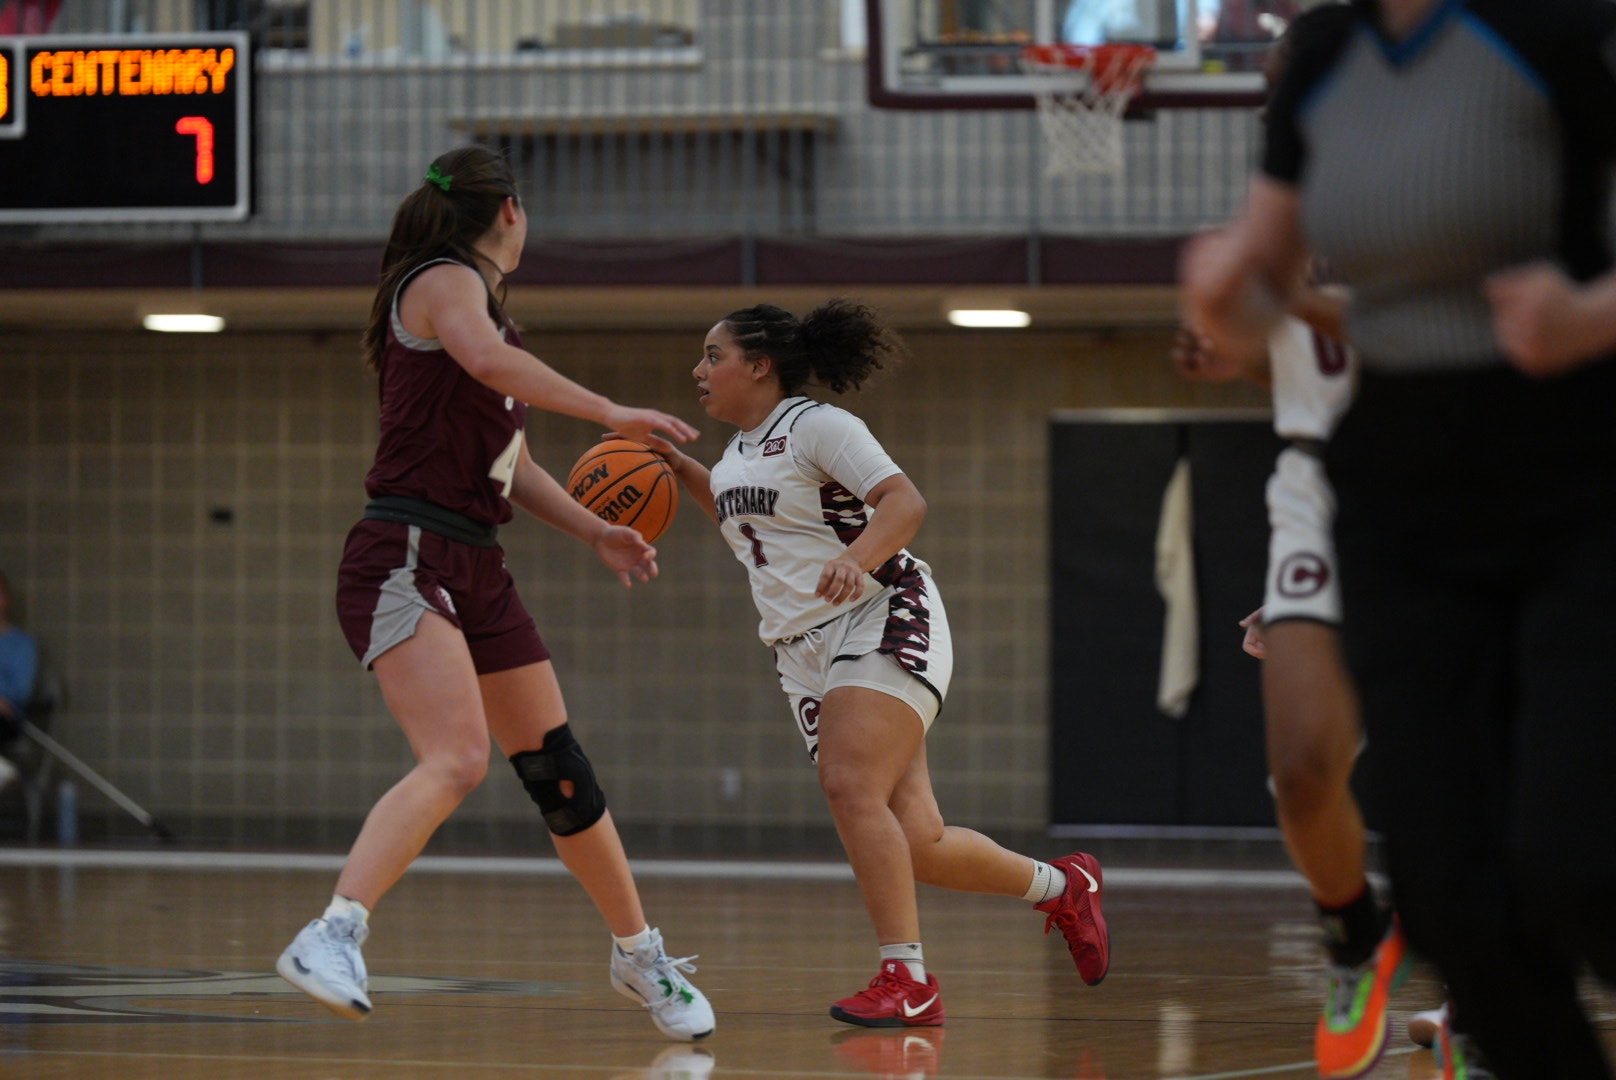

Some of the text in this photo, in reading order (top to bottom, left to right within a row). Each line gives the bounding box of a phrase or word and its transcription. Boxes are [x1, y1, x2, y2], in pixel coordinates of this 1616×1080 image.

[31, 48, 234, 96] CENTENARY
[176, 116, 214, 184] 7
[597, 485, 643, 522] Wils
[739, 523, 769, 568] 1
